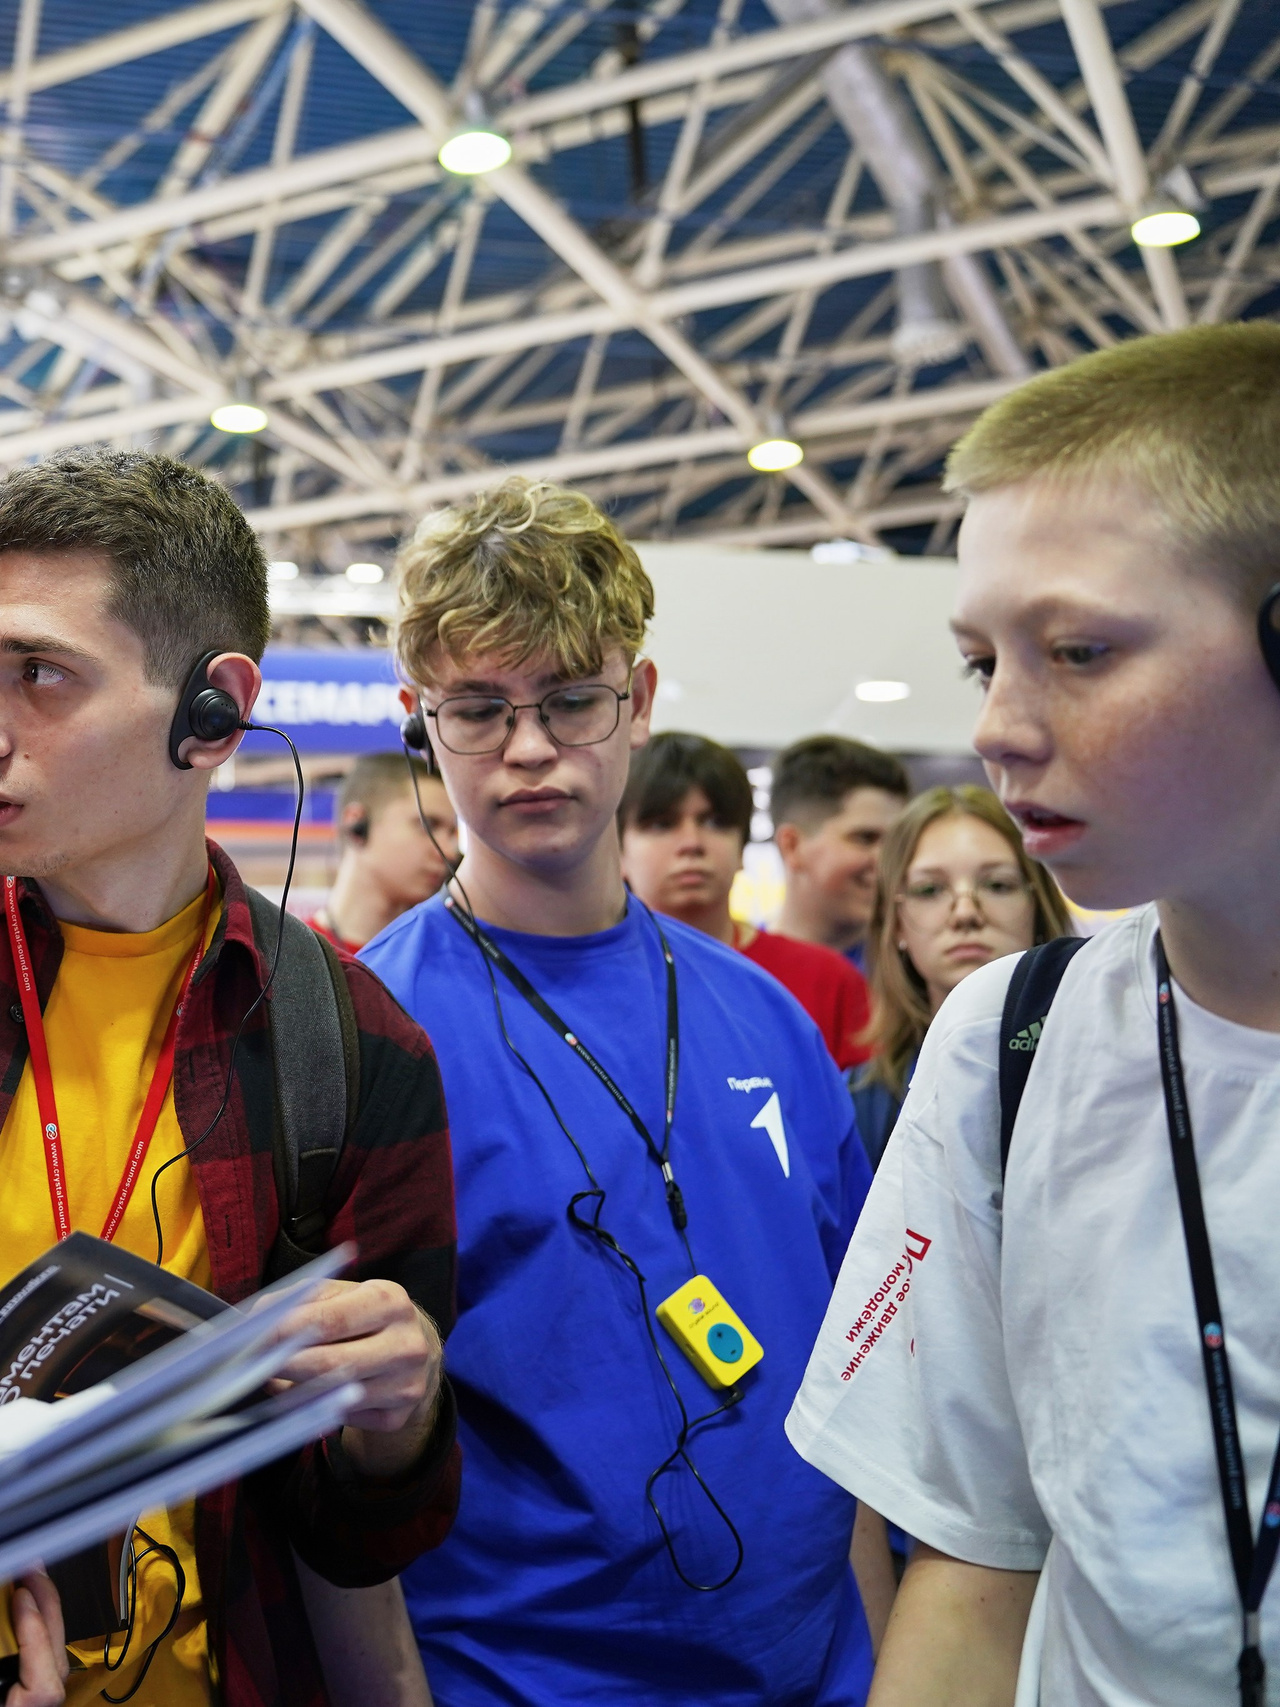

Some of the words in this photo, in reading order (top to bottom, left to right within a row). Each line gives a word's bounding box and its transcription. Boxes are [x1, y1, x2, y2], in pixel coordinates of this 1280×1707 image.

[8, 889, 31, 992] www.crystal-sound.com
[50, 1142, 68, 1242] www.crystal-sound.co
[20, 1288, 121, 1380] печати
[840, 1301, 899, 1382] движение
[845, 1262, 906, 1343] молодёжи
